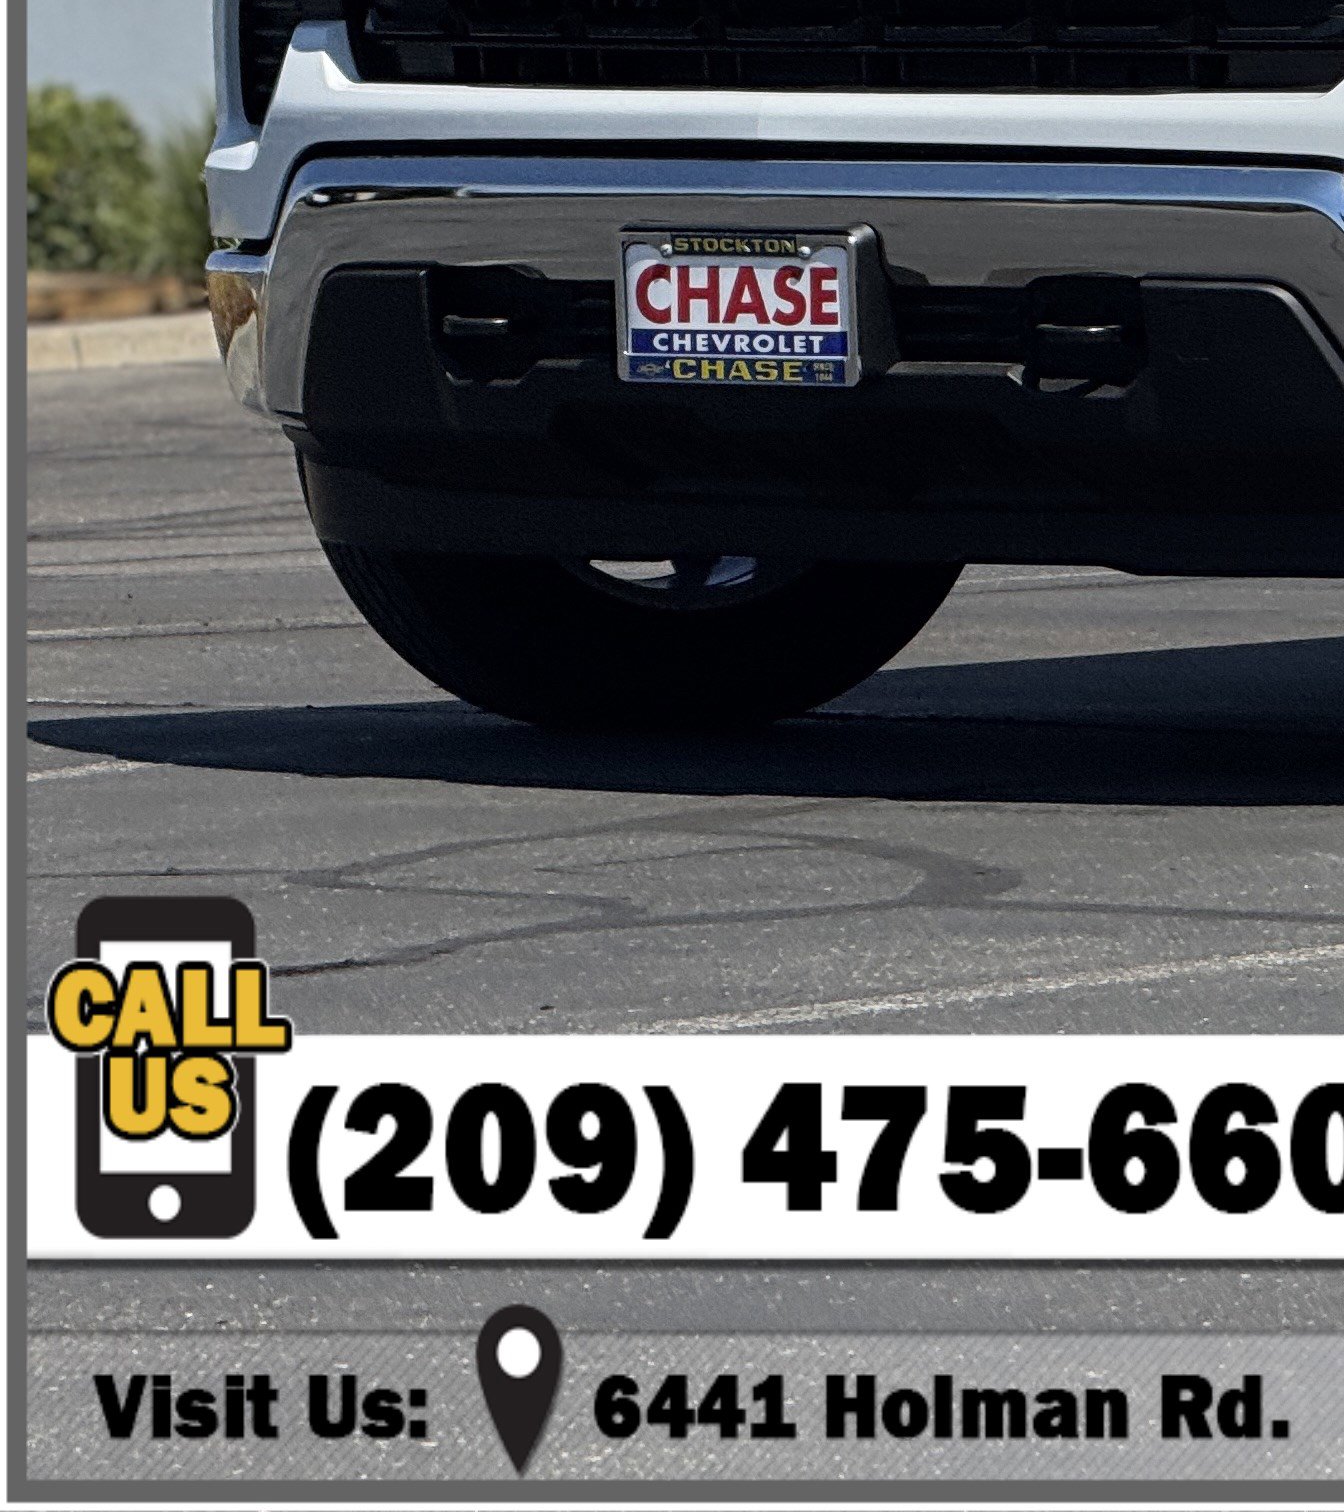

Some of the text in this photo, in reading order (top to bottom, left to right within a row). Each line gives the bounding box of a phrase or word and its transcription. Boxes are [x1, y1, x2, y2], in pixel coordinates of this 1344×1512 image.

[674, 238, 796, 254] STOCKTON
[635, 263, 839, 326] CHASE
[652, 333, 824, 353] CHEVROLET
[672, 359, 803, 380] CHASE
